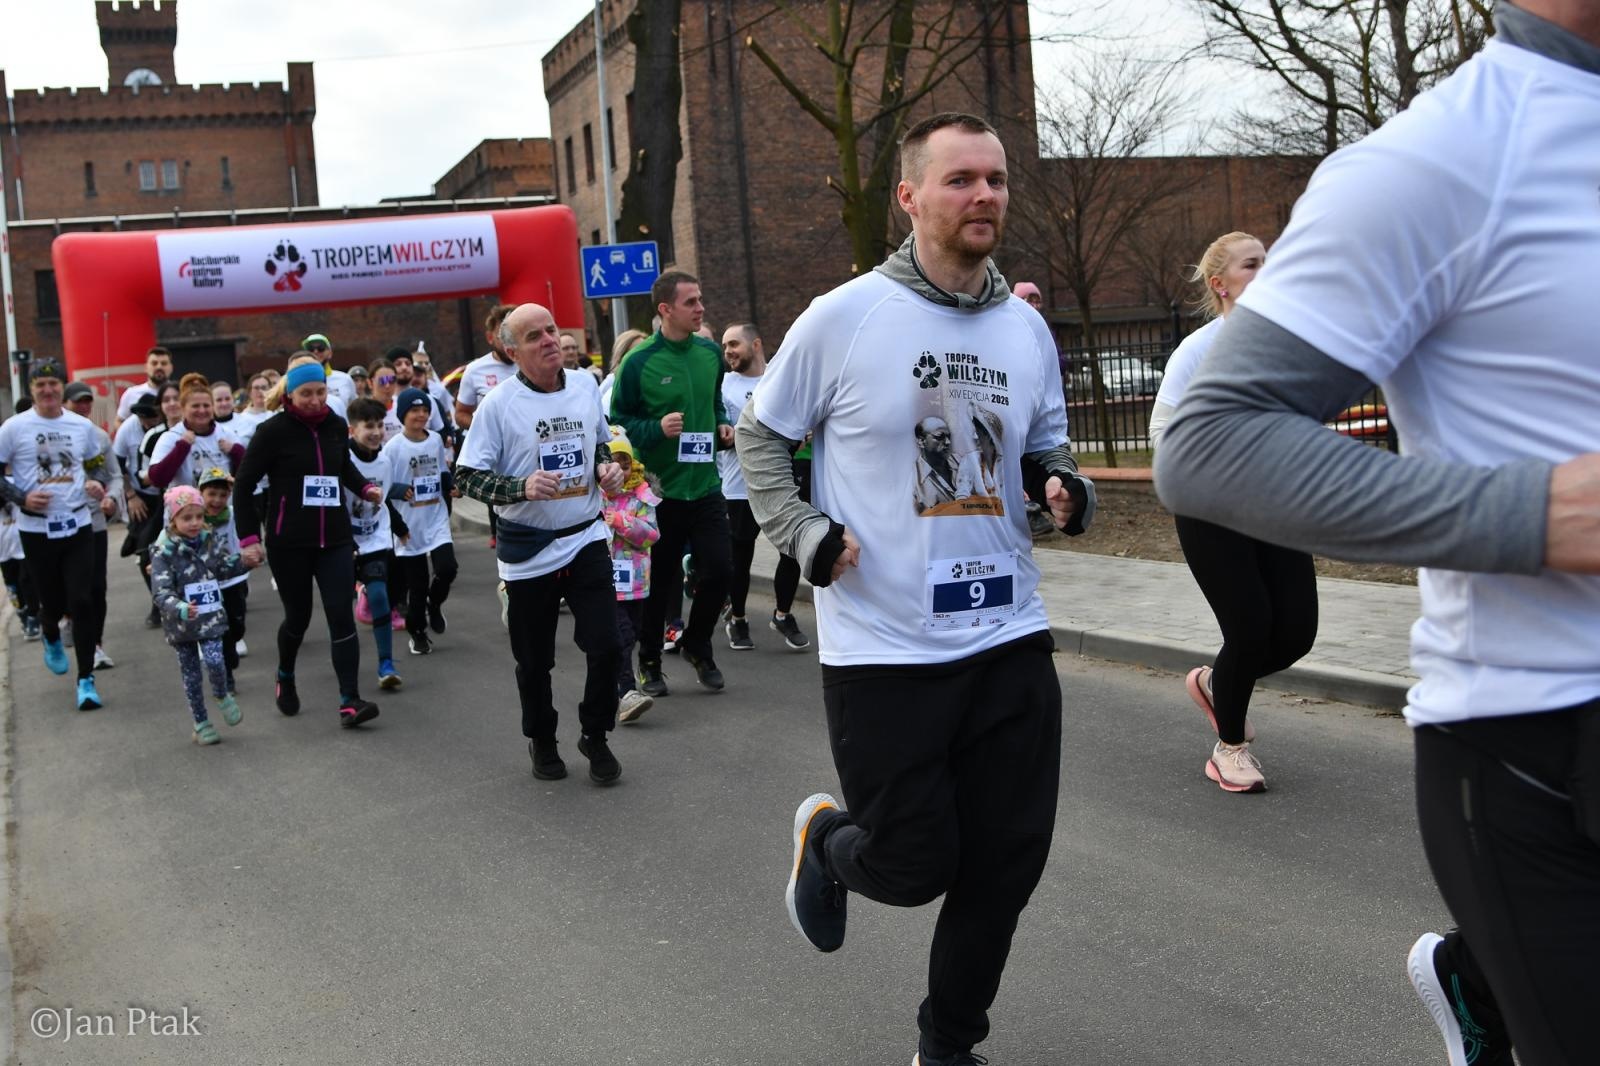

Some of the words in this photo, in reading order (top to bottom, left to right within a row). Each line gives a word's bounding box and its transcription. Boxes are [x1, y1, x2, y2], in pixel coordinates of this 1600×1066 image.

[945, 353, 979, 365] TROPEM
[947, 364, 1008, 387] WILCZYM
[949, 389, 961, 400] XIV
[962, 390, 989, 402] EDYCJA
[991, 394, 1009, 406] 2026
[552, 421, 584, 432] WILCZYM
[692, 443, 707, 454] 42
[558, 453, 576, 468] 29
[317, 487, 331, 498] 43
[965, 564, 996, 576] WILCZYM
[202, 592, 216, 604] 45
[969, 581, 986, 608] 9
